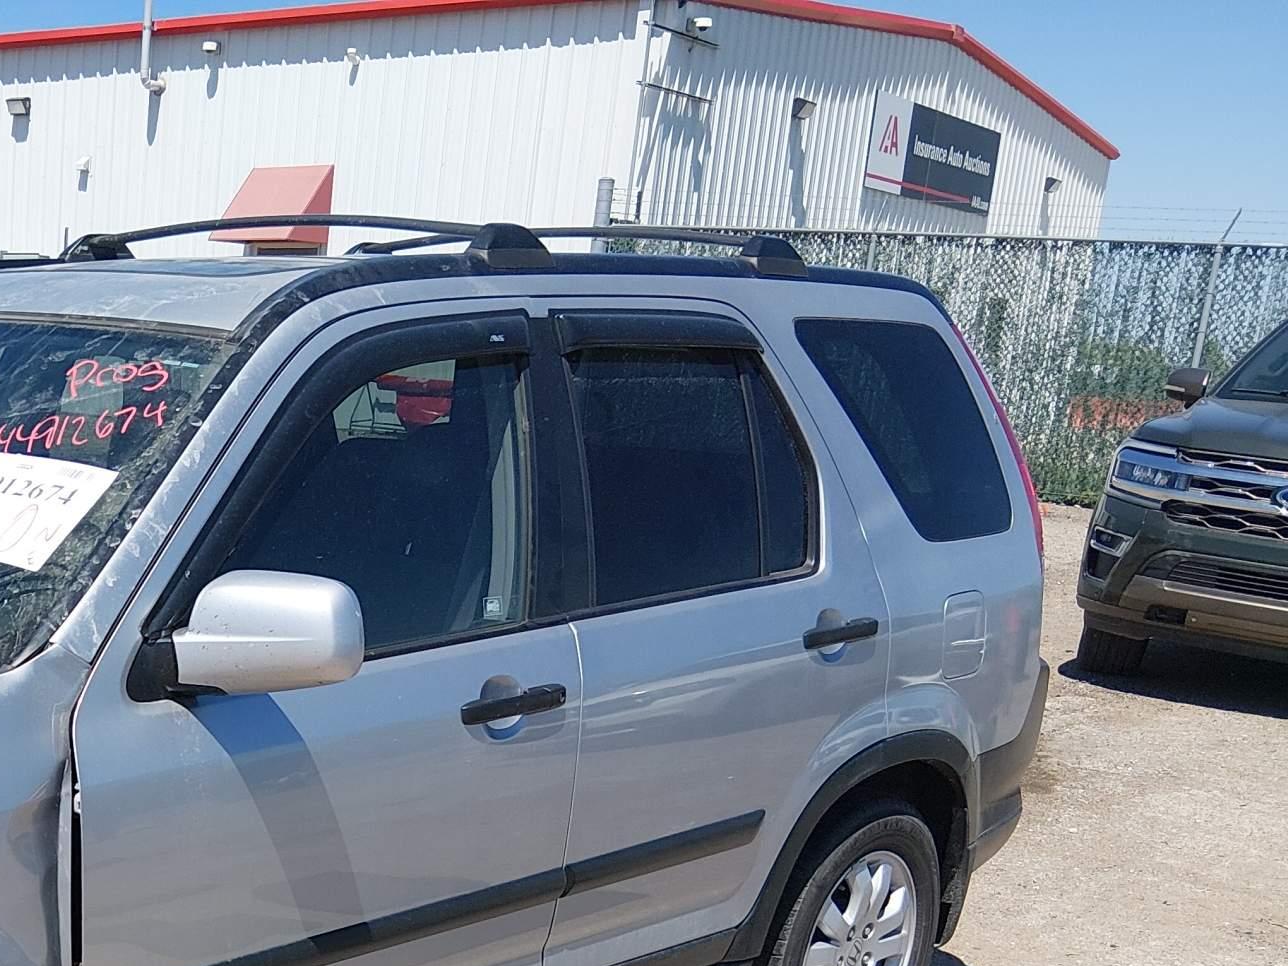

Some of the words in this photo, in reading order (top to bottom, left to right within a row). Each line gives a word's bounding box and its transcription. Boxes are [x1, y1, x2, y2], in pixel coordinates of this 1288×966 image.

[913, 134, 948, 163] Insurance
[947, 145, 963, 168] Auto
[962, 151, 991, 177] Auctions
